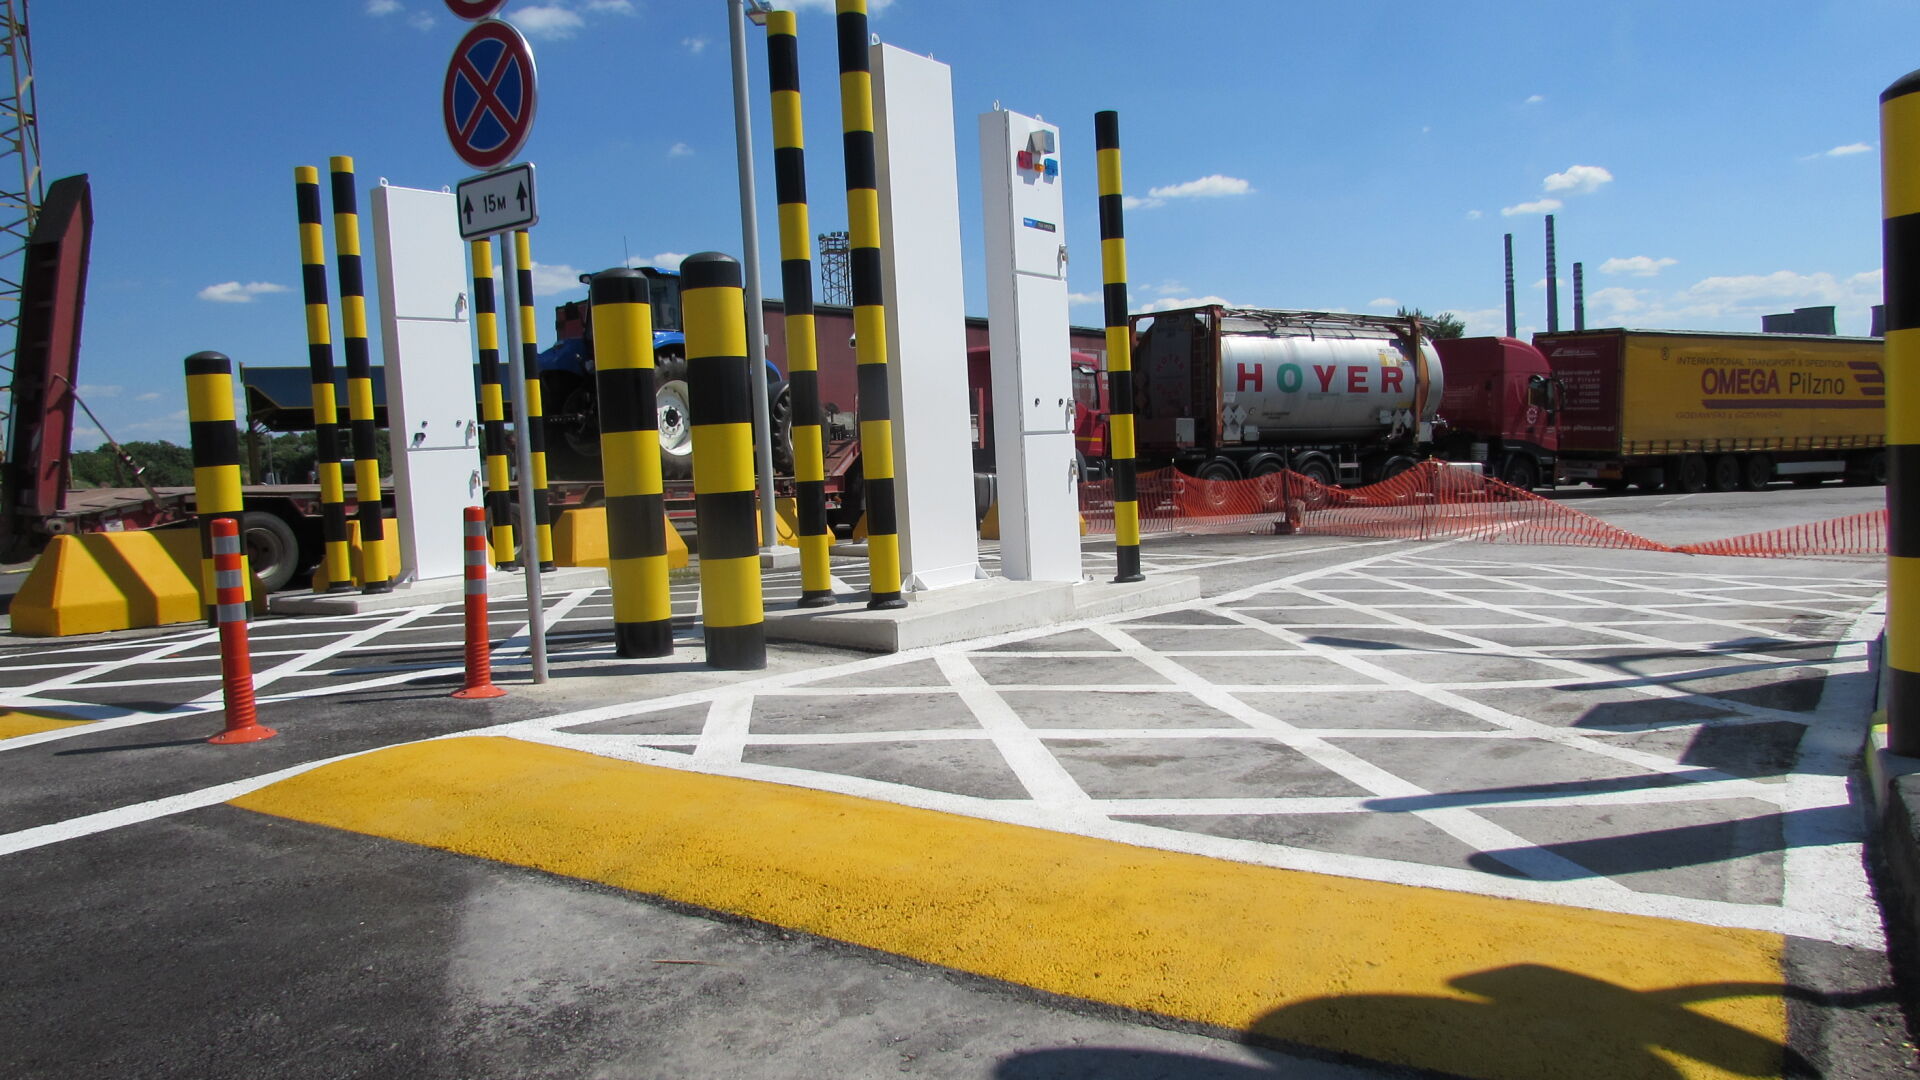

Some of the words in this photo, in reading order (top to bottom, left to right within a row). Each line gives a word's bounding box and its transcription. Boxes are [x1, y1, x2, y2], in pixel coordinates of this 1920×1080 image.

[1677, 356, 1744, 367] INTERNATIONAL
[1747, 358, 1796, 368] TRANSPORT
[1805, 360, 1845, 368] SPEDITION
[1237, 362, 1404, 394] HOYER
[1701, 368, 1780, 395] OMEGA
[1789, 372, 1845, 395] Pilzno
